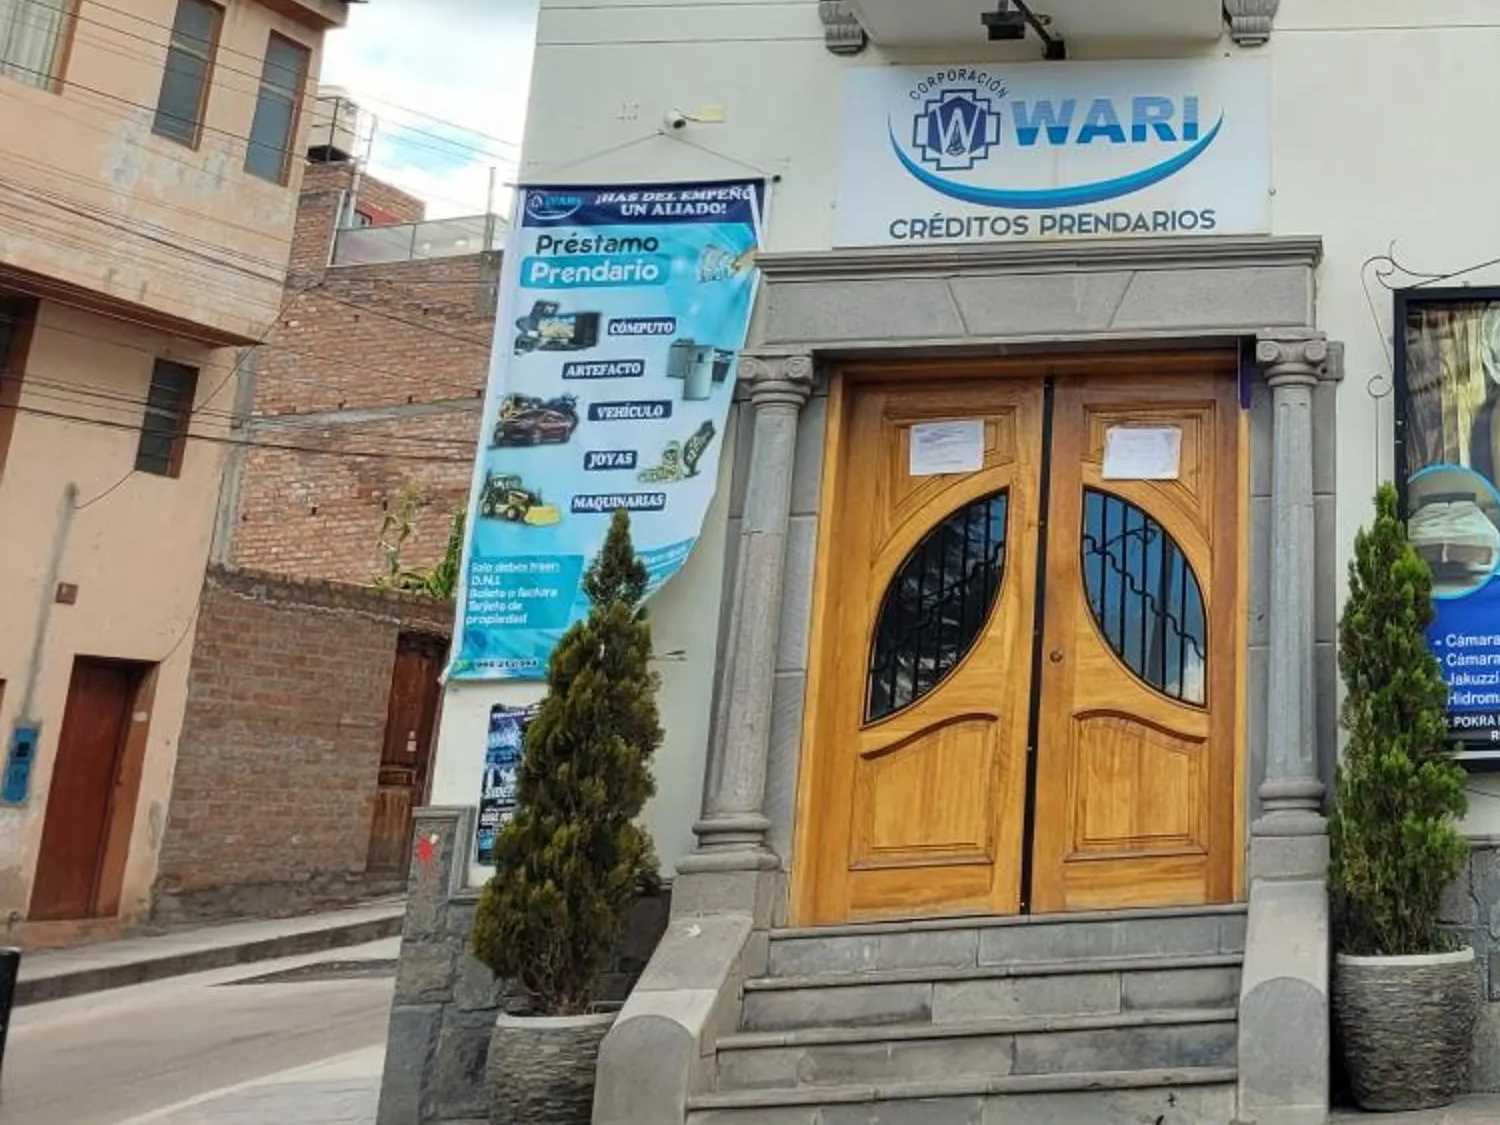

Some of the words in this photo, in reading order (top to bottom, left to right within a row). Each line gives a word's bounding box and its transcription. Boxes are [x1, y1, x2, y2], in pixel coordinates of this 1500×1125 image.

[909, 68, 1010, 100] CORPORACIÓN
[1011, 96, 1199, 146] WARI
[641, 191, 678, 203] DEL
[621, 203, 647, 216] UN
[652, 202, 728, 216] ALIADO!
[889, 212, 1029, 240] CRÉDITOS
[1039, 208, 1217, 236] PRENDARIOS
[536, 231, 660, 256] Préstamo
[530, 259, 660, 284] Prendario
[609, 321, 674, 334] CÓMPUTO
[565, 362, 641, 376] ARTEFACTO
[597, 402, 664, 418] VEHÍCULO
[588, 452, 634, 468] JOYAS
[572, 494, 665, 511] MAQUINARIAS
[1447, 671, 1499, 686] Jakuzzi
[1453, 714, 1497, 728] POKRA
